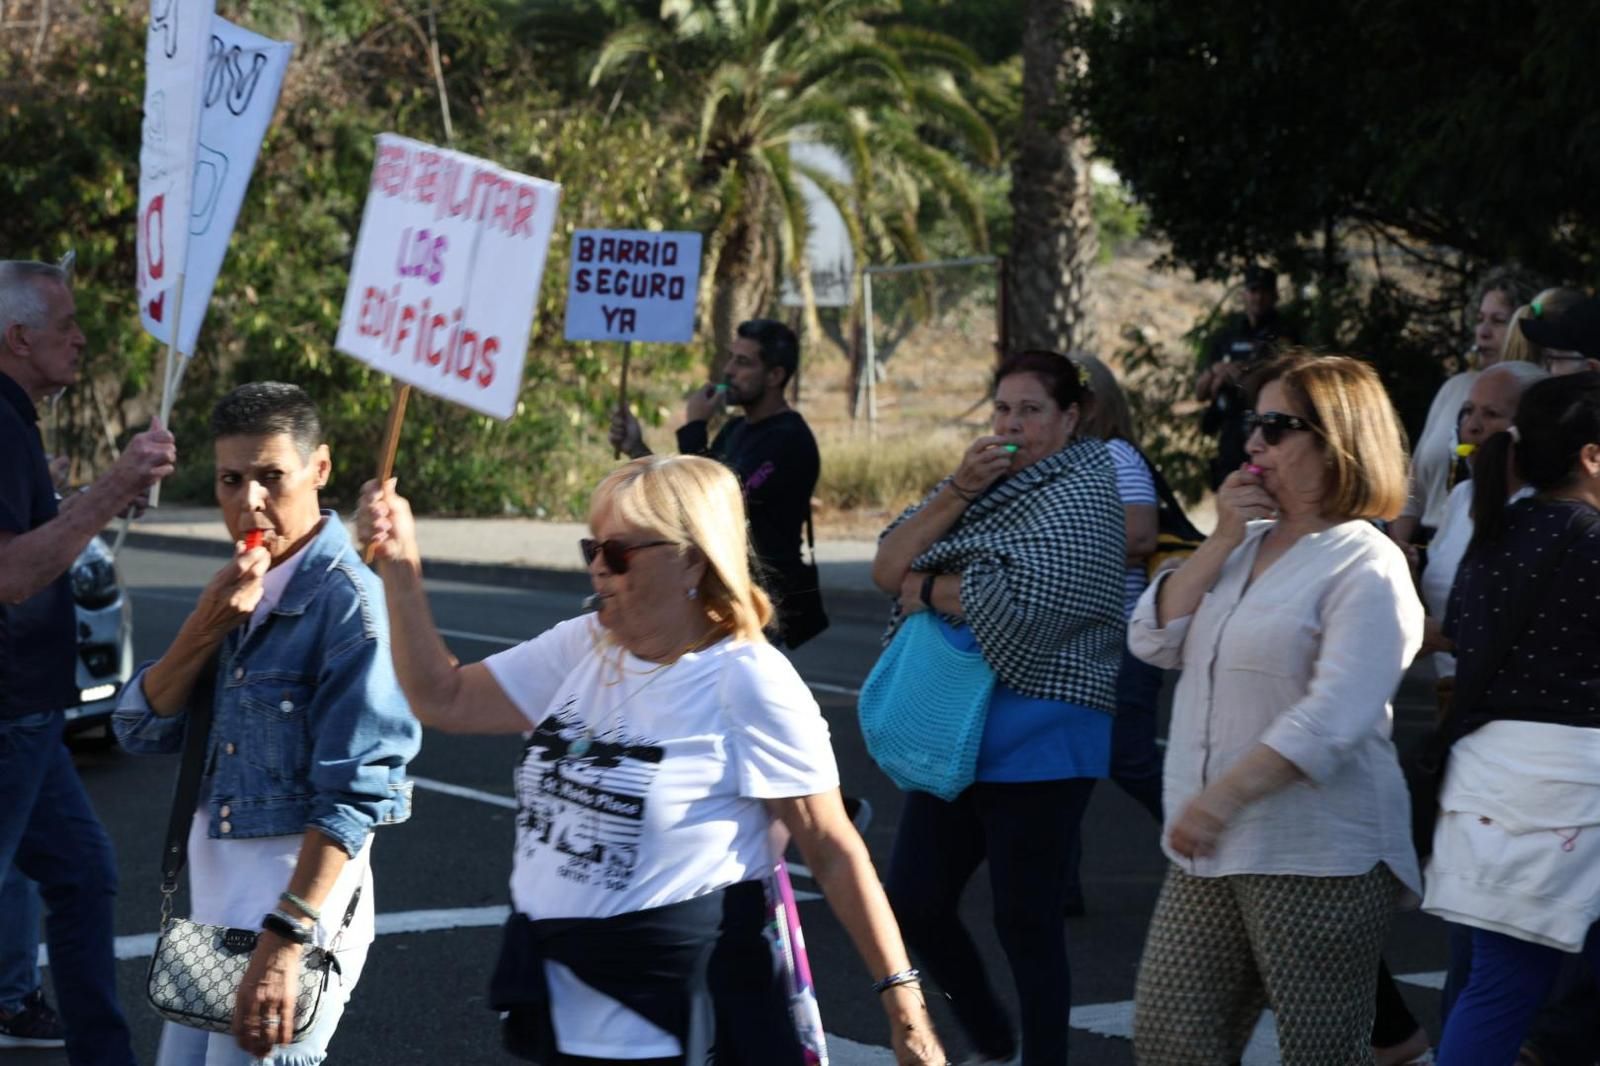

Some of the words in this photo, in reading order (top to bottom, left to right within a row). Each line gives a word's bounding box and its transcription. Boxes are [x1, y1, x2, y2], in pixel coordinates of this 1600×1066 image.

[396, 227, 447, 285] LOS
[578, 235, 678, 267] BARRIO
[576, 268, 685, 301] SEGURO
[601, 305, 636, 333] YA
